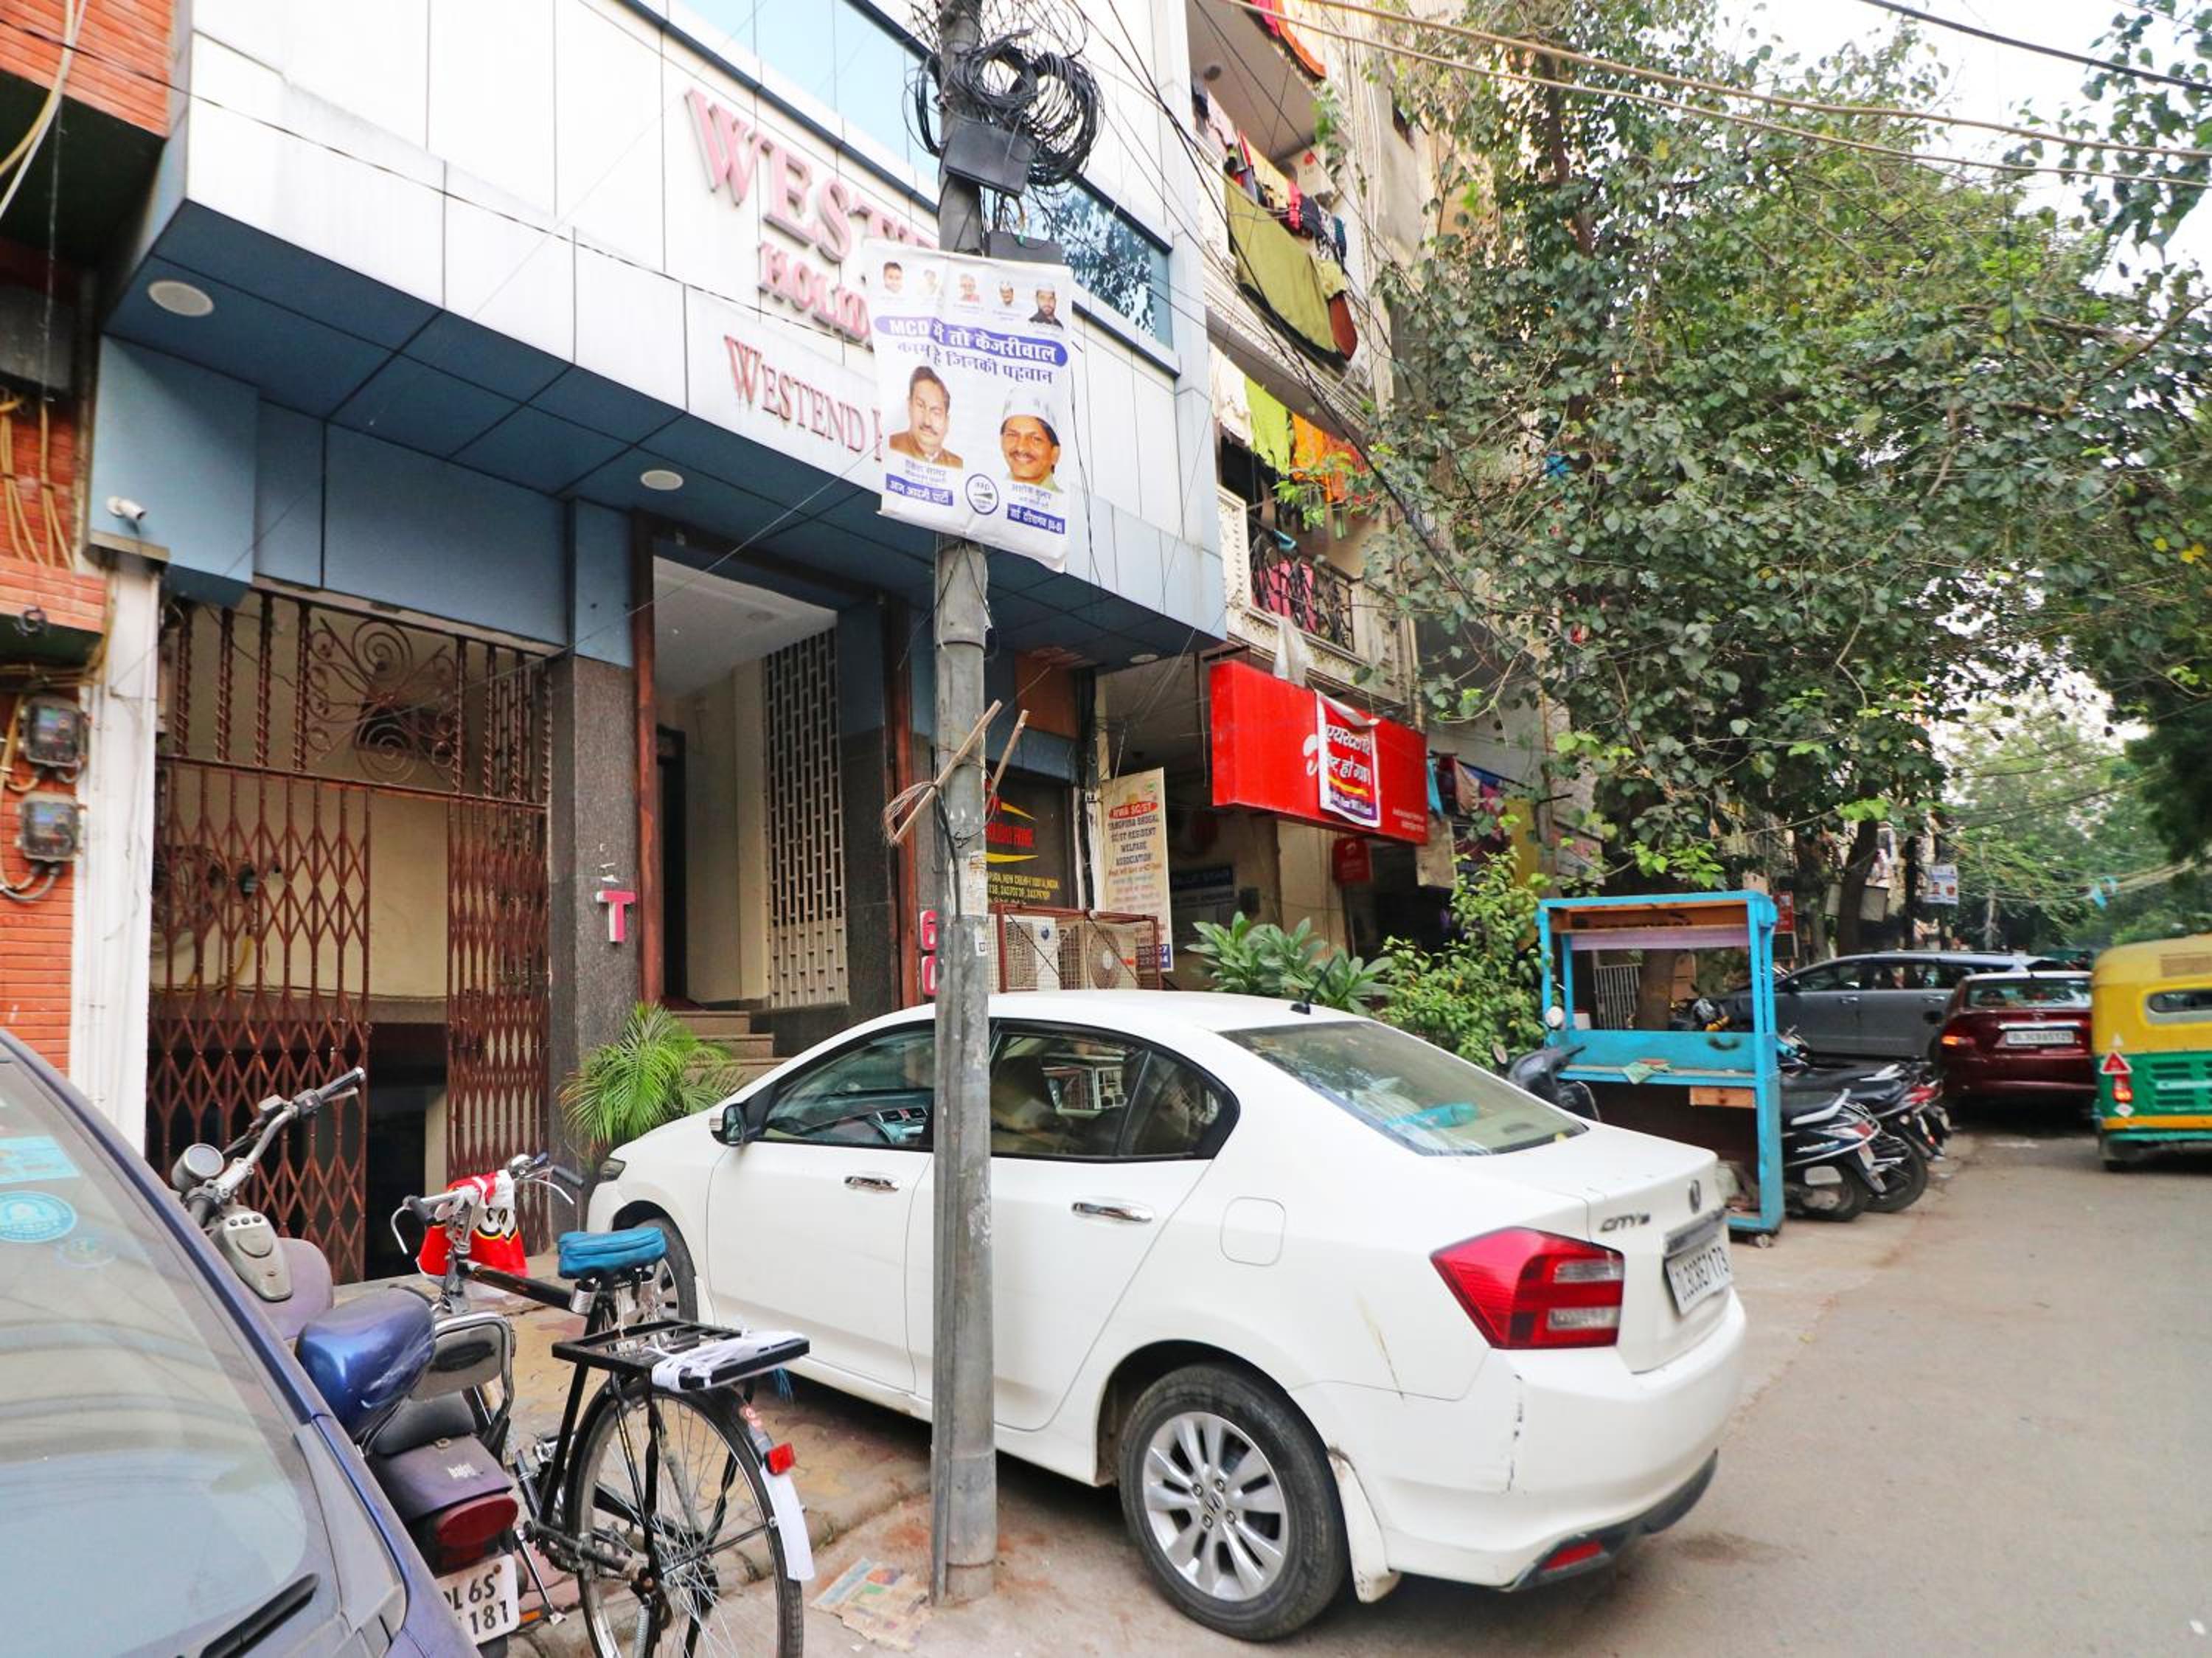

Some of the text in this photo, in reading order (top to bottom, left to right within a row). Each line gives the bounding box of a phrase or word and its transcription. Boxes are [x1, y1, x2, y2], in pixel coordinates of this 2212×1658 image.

[889, 318, 932, 336] MCD
[975, 326, 1057, 364] केजरीवाल
[946, 349, 998, 375] जिनकी
[723, 335, 863, 453] WESTEND
[596, 890, 637, 943] T
[468, 1573, 496, 1604] 6S
[457, 1599, 509, 1635] 181
